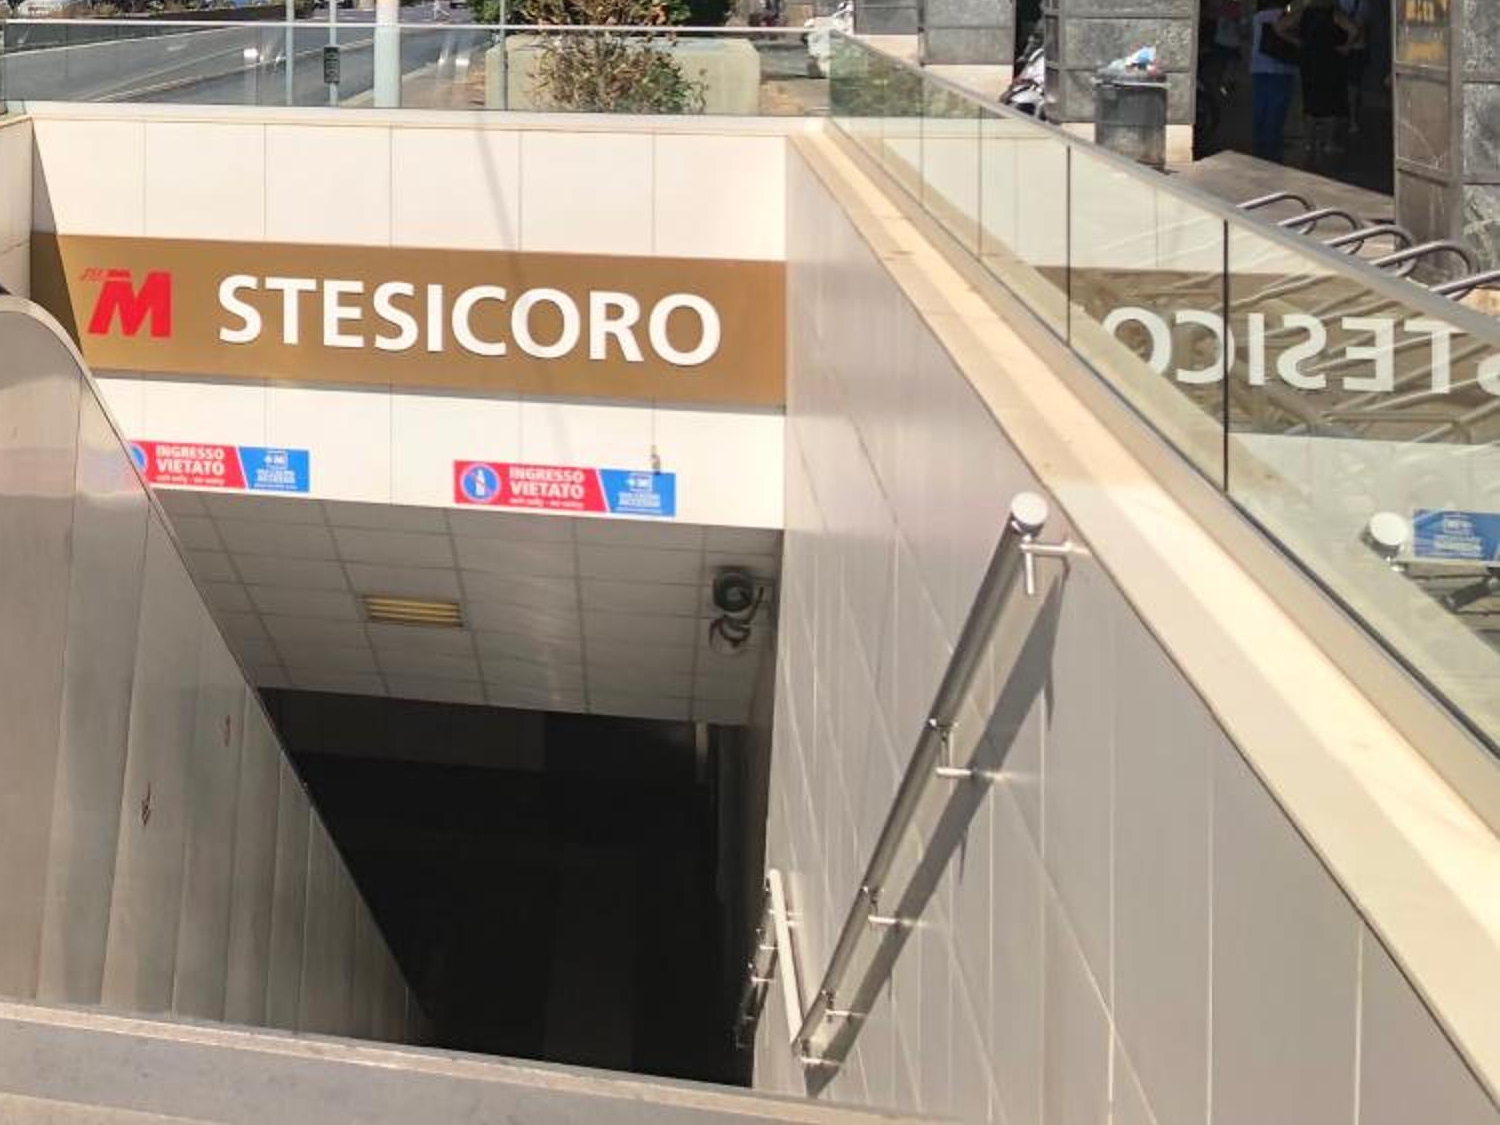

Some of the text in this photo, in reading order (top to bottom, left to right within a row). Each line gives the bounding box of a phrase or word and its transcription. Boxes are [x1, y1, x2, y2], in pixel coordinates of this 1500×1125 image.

[217, 274, 722, 367] STESICORO
[155, 444, 225, 461] INGRESSO
[155, 459, 225, 476] VIETATO
[509, 466, 585, 483] INGRESSO
[509, 481, 585, 500] VIETATO
